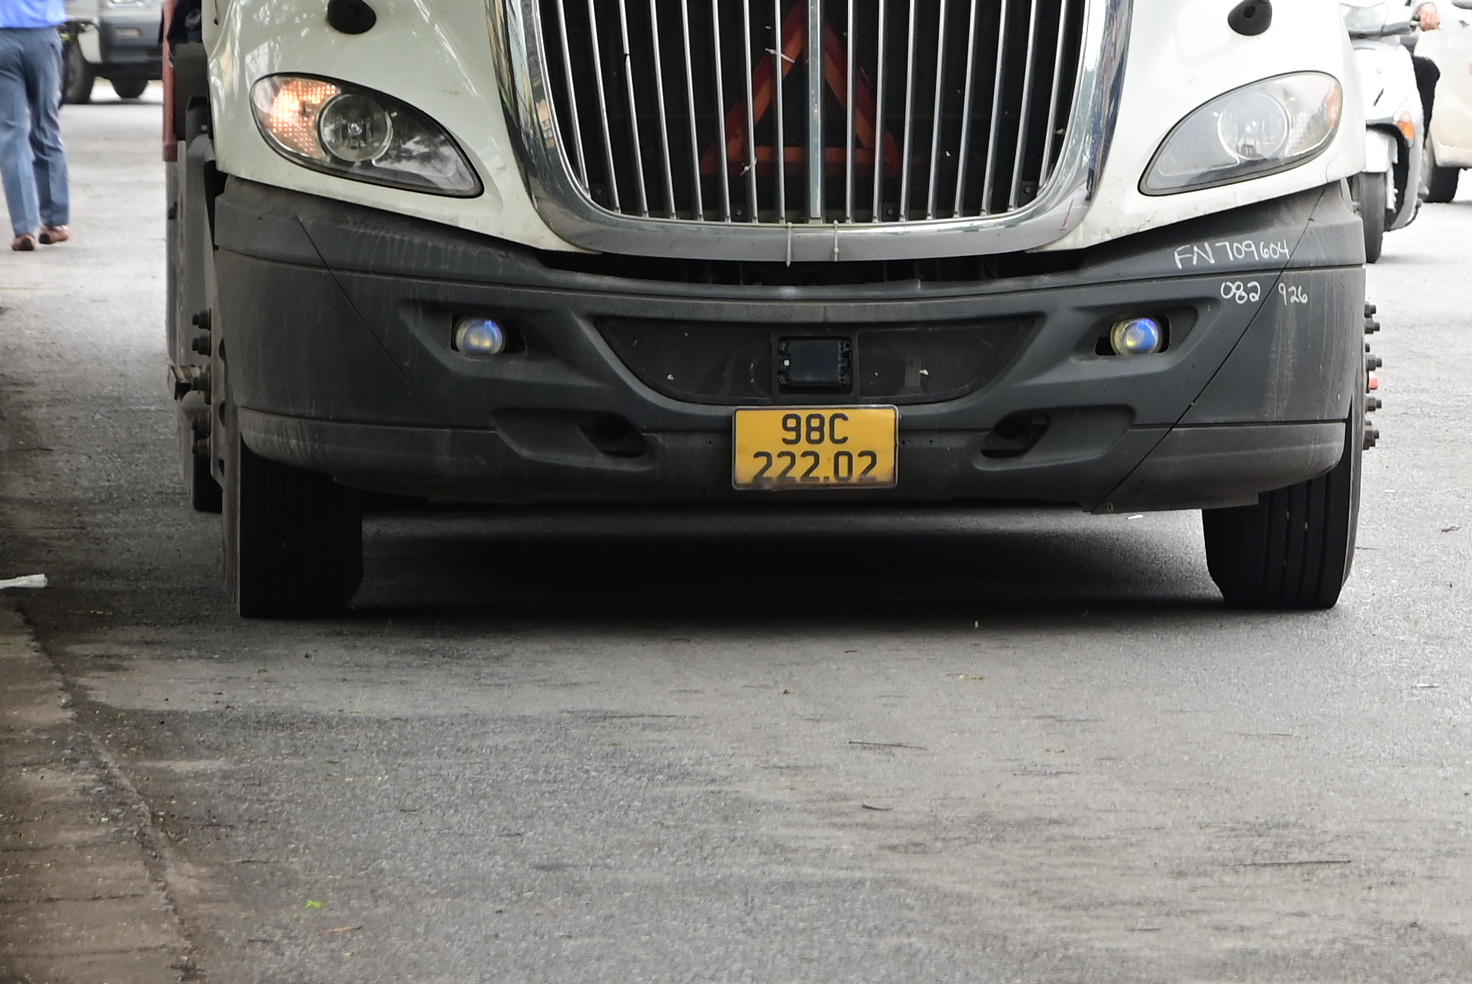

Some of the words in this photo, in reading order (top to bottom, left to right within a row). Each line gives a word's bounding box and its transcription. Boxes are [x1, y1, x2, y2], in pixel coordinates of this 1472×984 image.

[1220, 281, 1261, 304] 082
[1278, 282, 1309, 306] 926
[781, 412, 849, 445] 98C
[752, 450, 878, 483] 222.02
